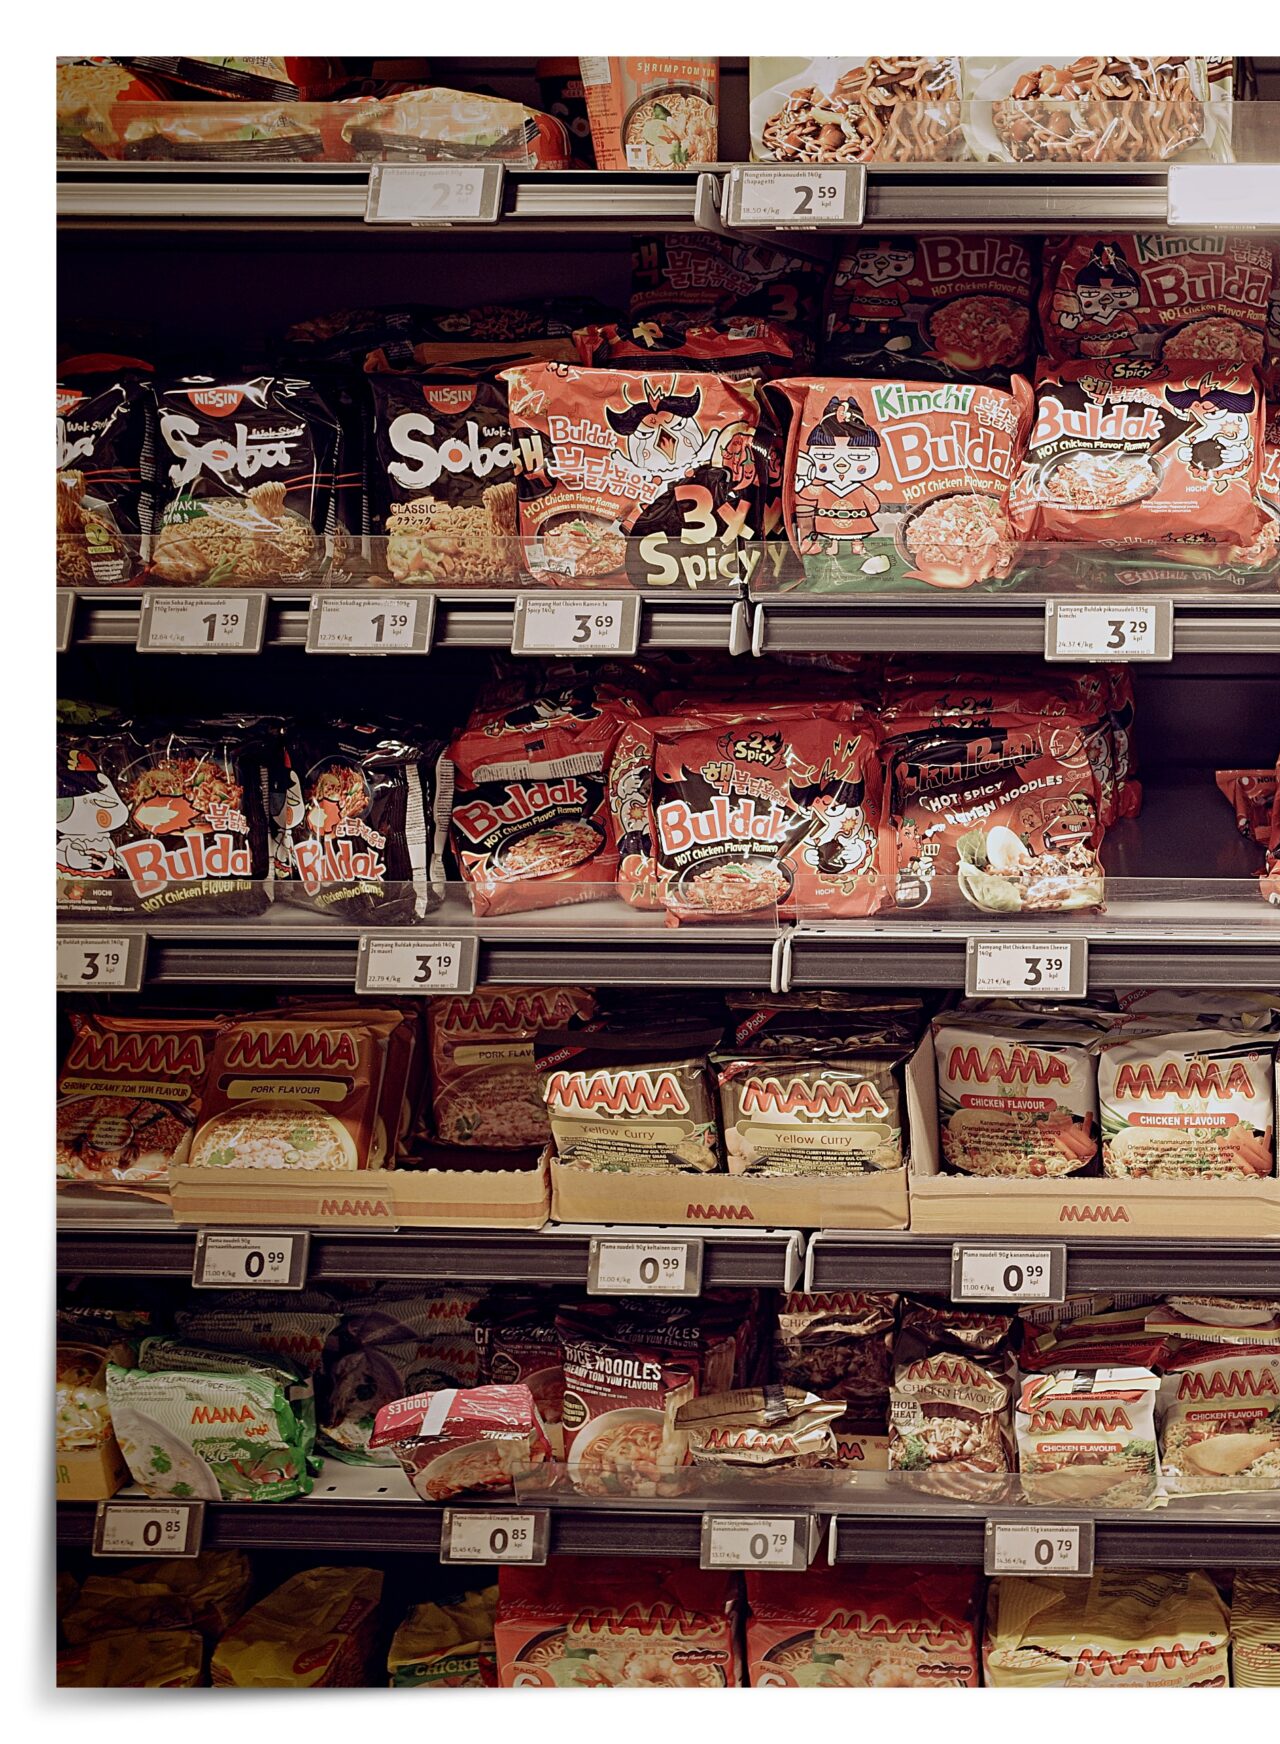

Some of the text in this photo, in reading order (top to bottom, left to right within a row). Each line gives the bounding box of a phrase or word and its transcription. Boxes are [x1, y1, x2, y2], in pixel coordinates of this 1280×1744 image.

[637, 62, 700, 76] SHRIMP TOM
[794, 185, 837, 214] 2 59
[194, 390, 239, 408] NISSIN
[429, 389, 473, 403] NISSIN
[872, 384, 976, 421] Kimchi
[547, 416, 617, 448] Buldak
[1030, 396, 1165, 449] Buldak
[159, 415, 292, 488] Soba
[387, 412, 512, 489] Soba
[1037, 439, 1150, 459] HOT Chicken Flavor Ramen
[390, 503, 437, 515] CLASSIC
[639, 531, 761, 590] Spicy
[202, 614, 239, 641] 1 39
[371, 614, 408, 642] 1 39
[572, 615, 613, 642] 3 69
[1107, 621, 1148, 648] 3 29
[735, 740, 774, 764] Spicy
[452, 779, 588, 843] Buldak
[657, 797, 791, 854] Buldak
[675, 843, 778, 867] HOT Chicken Flavor Ramen
[81, 953, 119, 981] 3 19
[414, 955, 452, 983] 3 19
[1024, 958, 1042, 986] 3
[1046, 959, 1062, 970] 39
[69, 1034, 203, 1075] MAMA
[225, 1029, 359, 1069] MAMA
[948, 1046, 1072, 1085] MAMA
[250, 1084, 321, 1095] PORK FLAVOUR
[543, 1071, 691, 1114] MAMA
[1114, 1062, 1256, 1100] MAMA
[740, 1078, 889, 1118] MAMA
[580, 1124, 655, 1141] Yellow Curry
[1139, 1115, 1226, 1126] CHICKEN FLAVOUR
[775, 1132, 852, 1147] Yellow Curry
[320, 1200, 389, 1217] MAMA
[686, 1204, 754, 1220] MAMA
[245, 1251, 284, 1278] 0 99
[640, 1258, 679, 1284] 0 99
[1003, 1265, 1043, 1292] 0 99
[564, 1347, 662, 1381] RICE NOODLES
[1190, 1409, 1264, 1421] CHICKEN FLAVOUR
[1042, 1444, 1118, 1453] CHICKEN FLAVOUR
[142, 1519, 180, 1547] 0 85
[489, 1528, 527, 1555] 0 85
[1034, 1539, 1072, 1566] 0 79
